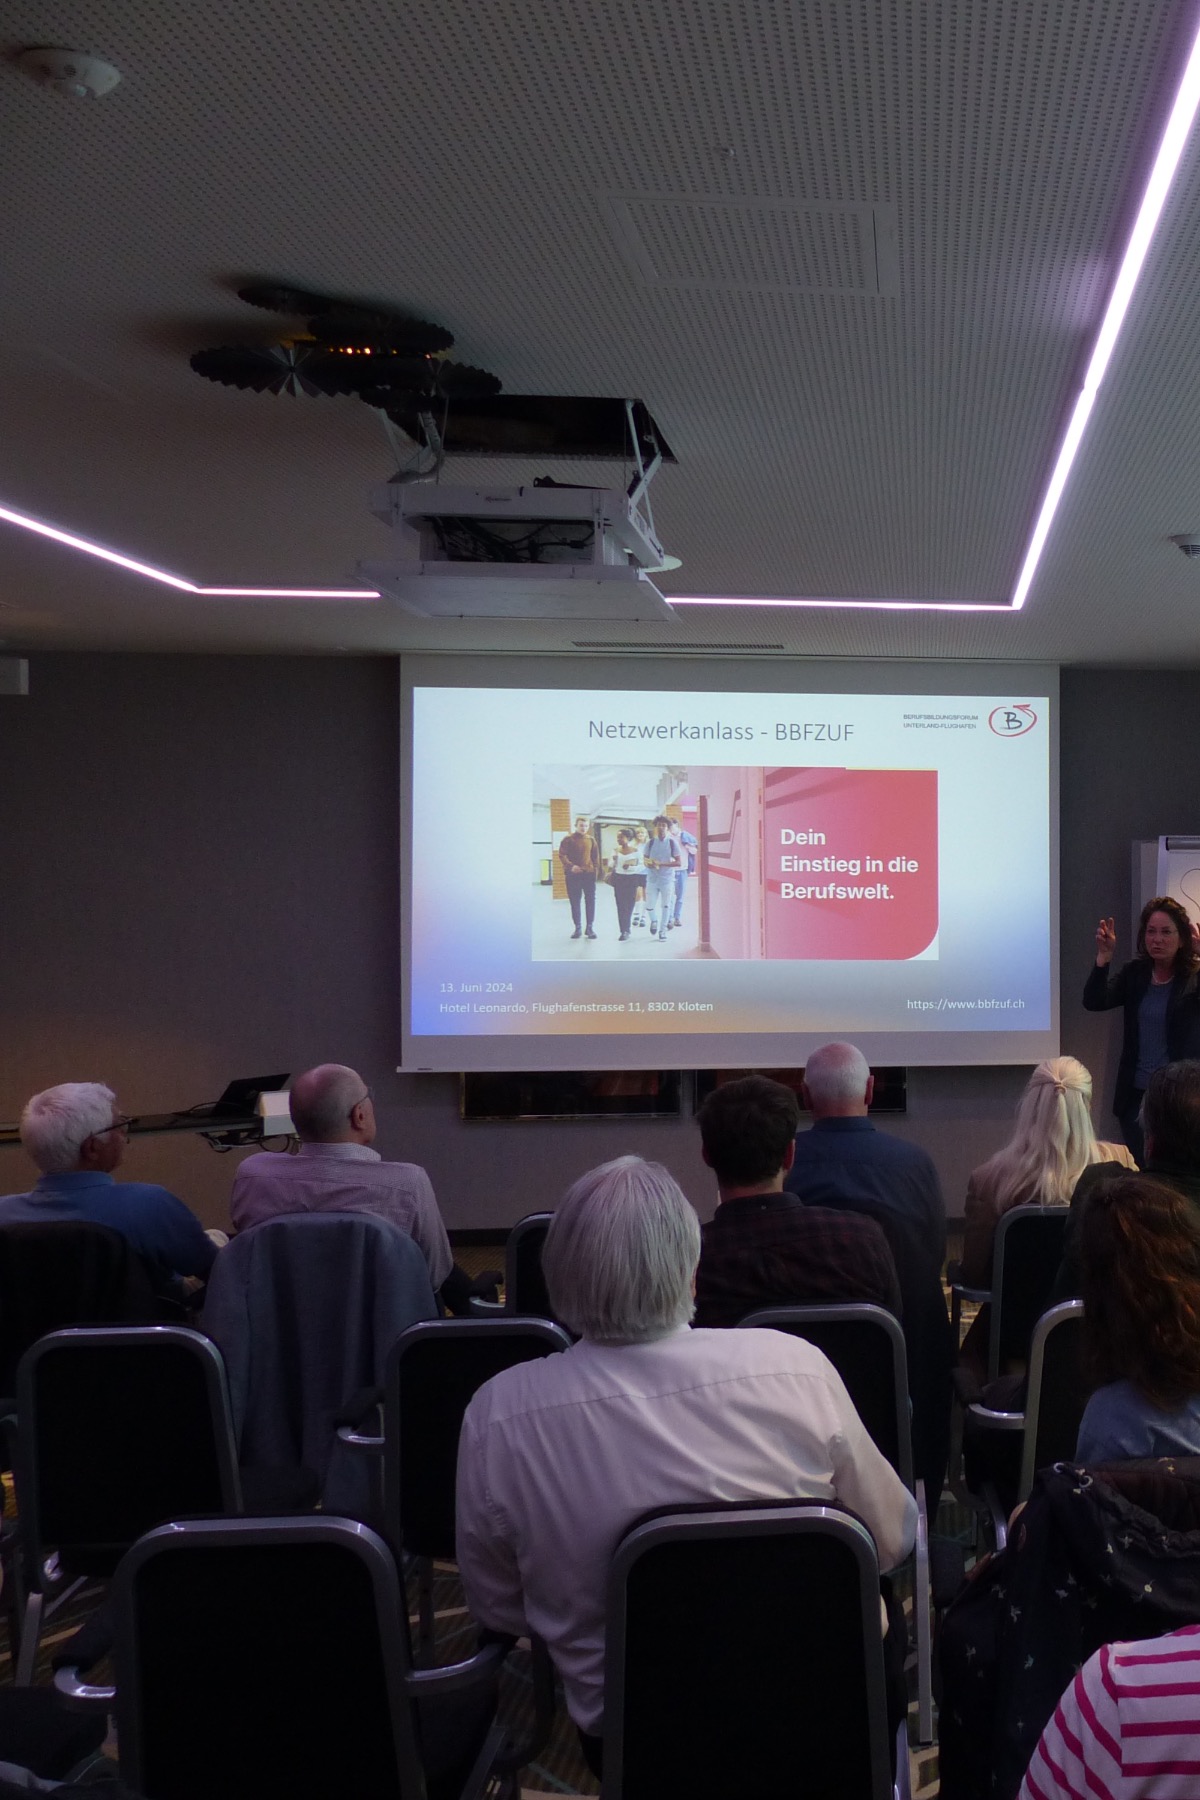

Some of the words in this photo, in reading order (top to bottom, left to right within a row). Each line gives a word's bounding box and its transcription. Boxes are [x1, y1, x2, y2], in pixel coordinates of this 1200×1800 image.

[902, 713, 979, 721] BERUFSBILDUNGSFORUM
[1002, 711, 1023, 730] B
[588, 720, 754, 740] Netzwerkanlass
[774, 723, 855, 741] BBFZUF
[780, 828, 826, 845] Dein
[780, 855, 861, 876] Einstieg
[865, 855, 883, 872] in
[888, 856, 919, 873] die
[780, 882, 895, 899] Berufswelt.
[440, 982, 458, 993] 13.
[460, 982, 483, 993] Juni
[485, 982, 514, 993] 2024
[440, 1002, 470, 1013] Hotel
[473, 1002, 529, 1014] Leonardo,
[532, 1002, 625, 1014] Flughafenstrasse
[628, 1002, 645, 1013] 11,
[647, 1001, 675, 1012] 8302
[678, 1001, 714, 1012] Kloten
[907, 998, 1025, 1011] https://www.bbfzuf.ch
